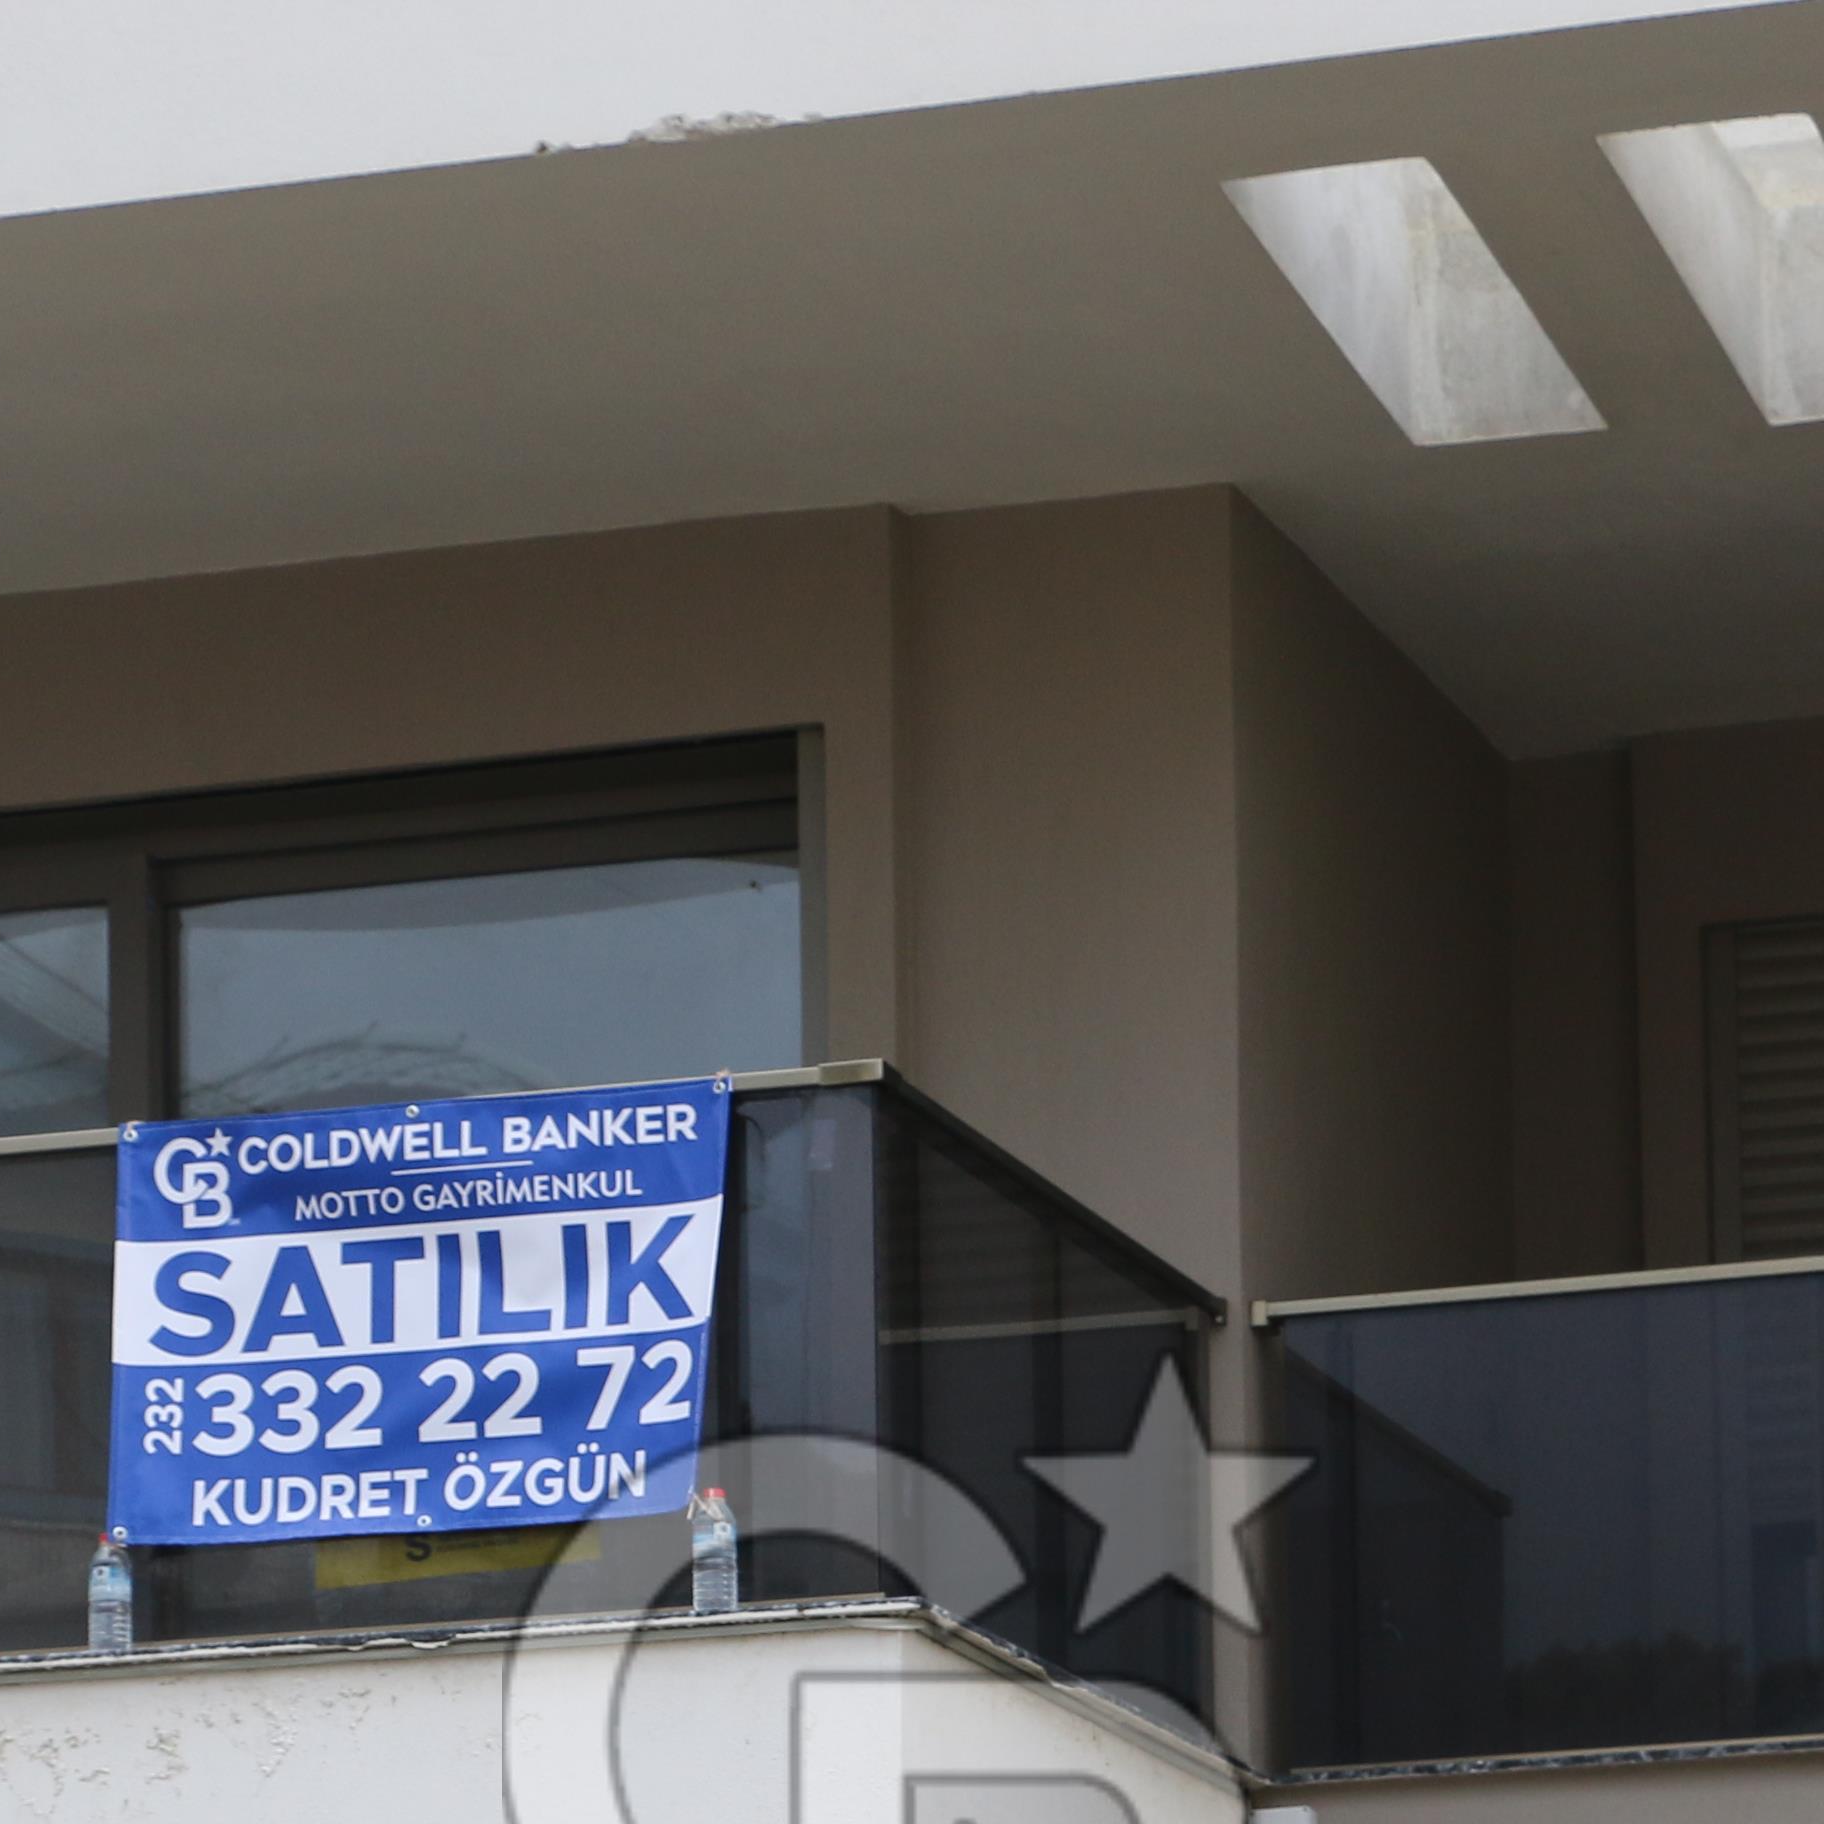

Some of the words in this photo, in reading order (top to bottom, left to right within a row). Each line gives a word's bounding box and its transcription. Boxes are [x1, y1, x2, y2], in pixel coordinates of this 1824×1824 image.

[238, 1120, 488, 1174] COLDWELL
[502, 1103, 697, 1154] BANKER
[153, 1137, 233, 1229] CB
[295, 1187, 404, 1222] MOTTO
[413, 1169, 643, 1211] GAYRİMENKUL
[149, 1214, 695, 1357] SATILIK
[143, 1377, 184, 1455] 232
[192, 1365, 383, 1456] 332
[418, 1352, 542, 1443] 22
[576, 1339, 693, 1431] 72
[192, 1468, 429, 1527] KUDRET
[443, 1442, 646, 1511] ÖZGÜN
